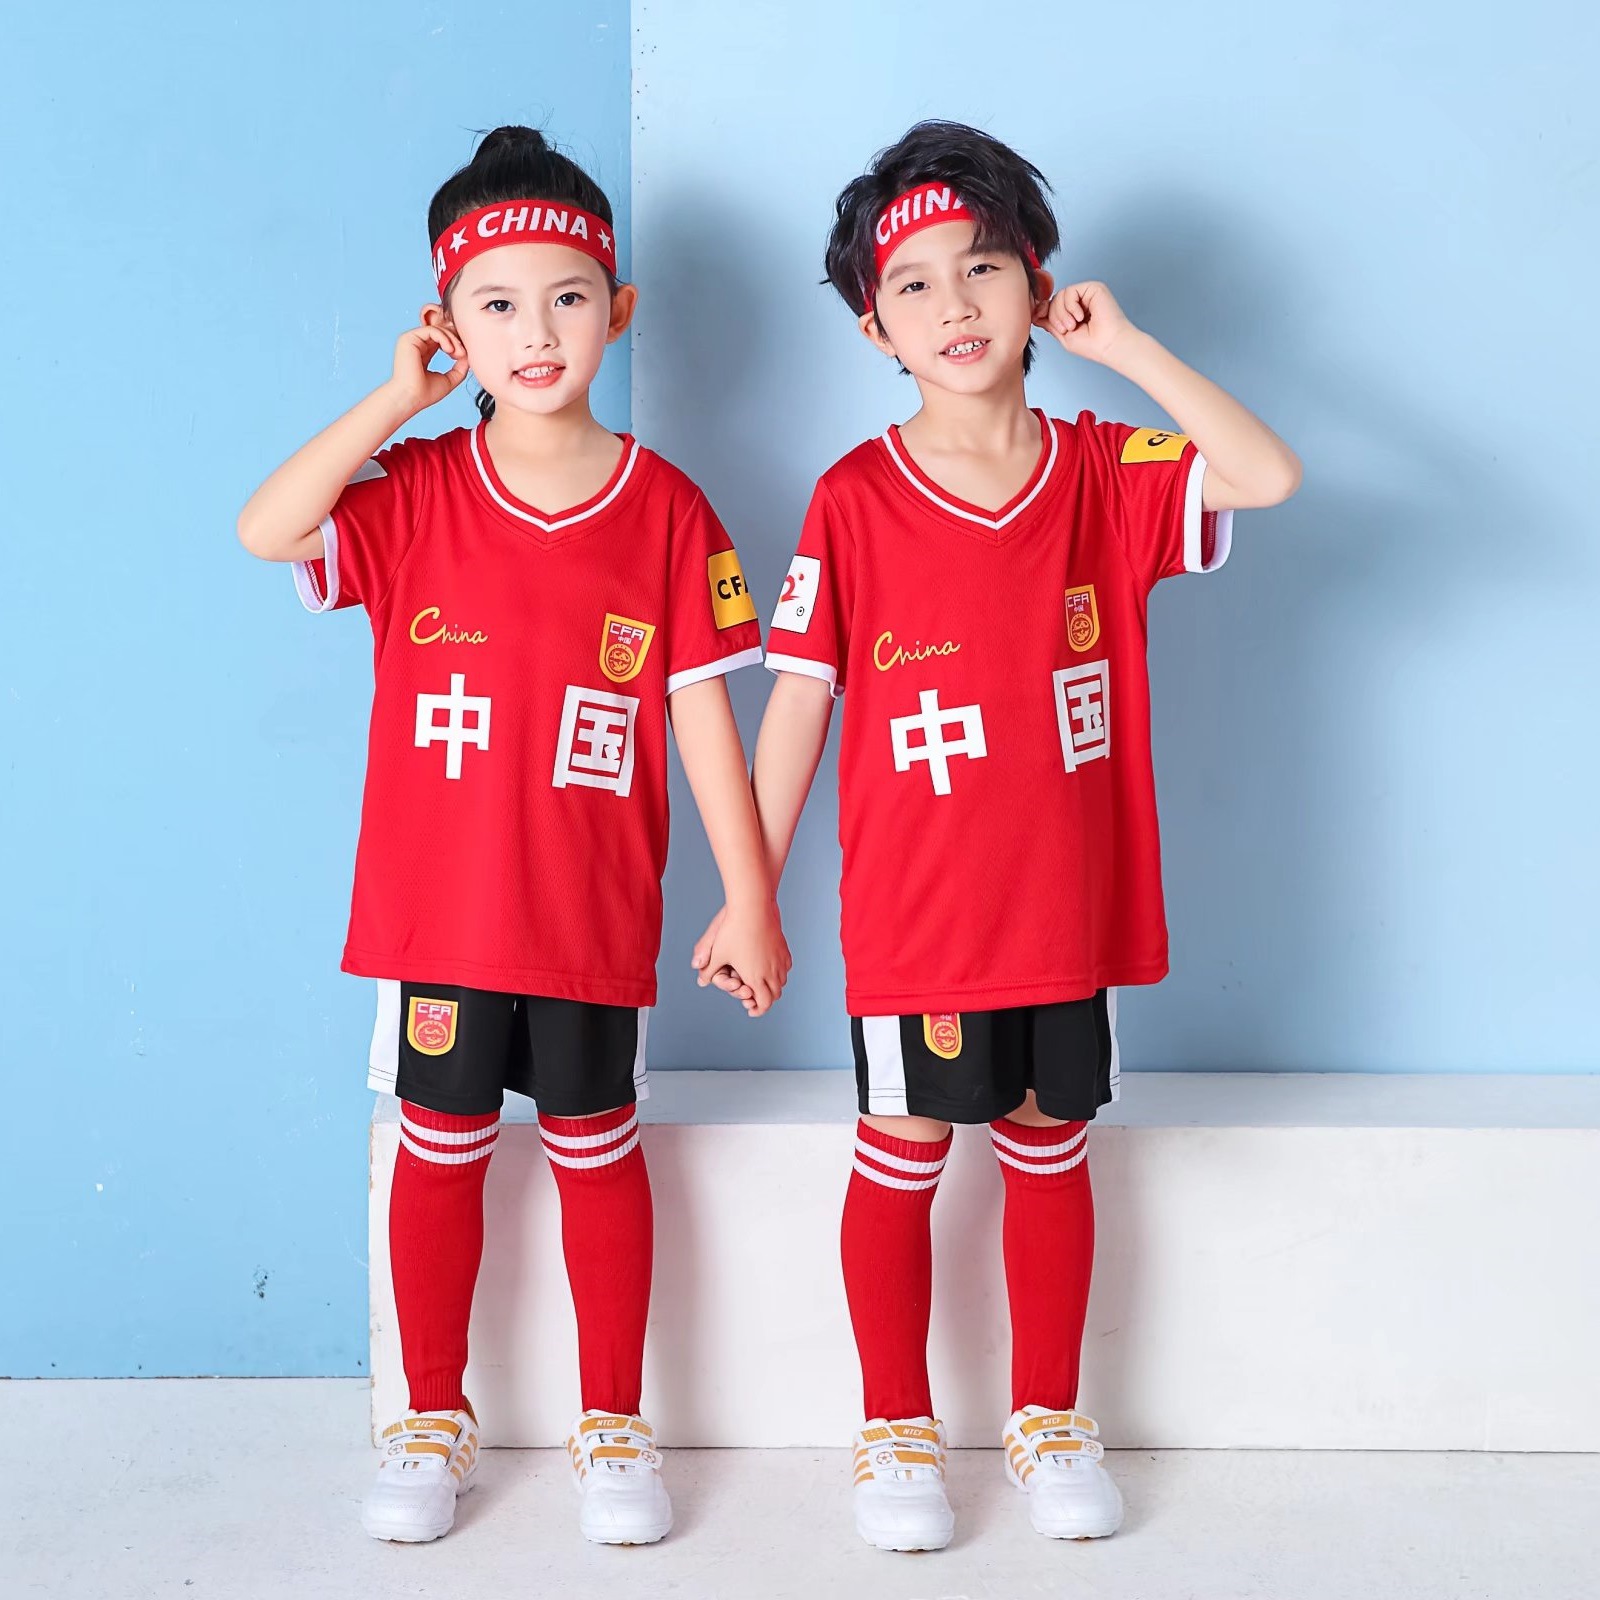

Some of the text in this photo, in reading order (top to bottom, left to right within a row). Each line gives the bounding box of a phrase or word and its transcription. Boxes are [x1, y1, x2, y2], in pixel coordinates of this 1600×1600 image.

[477, 207, 588, 240] CHINA
[1066, 592, 1090, 608] CFA
[410, 607, 488, 645] China
[609, 622, 646, 641] CFA
[873, 631, 961, 672] China
[417, 1003, 451, 1016] CFA
[596, 1419, 617, 1427] NTCF
